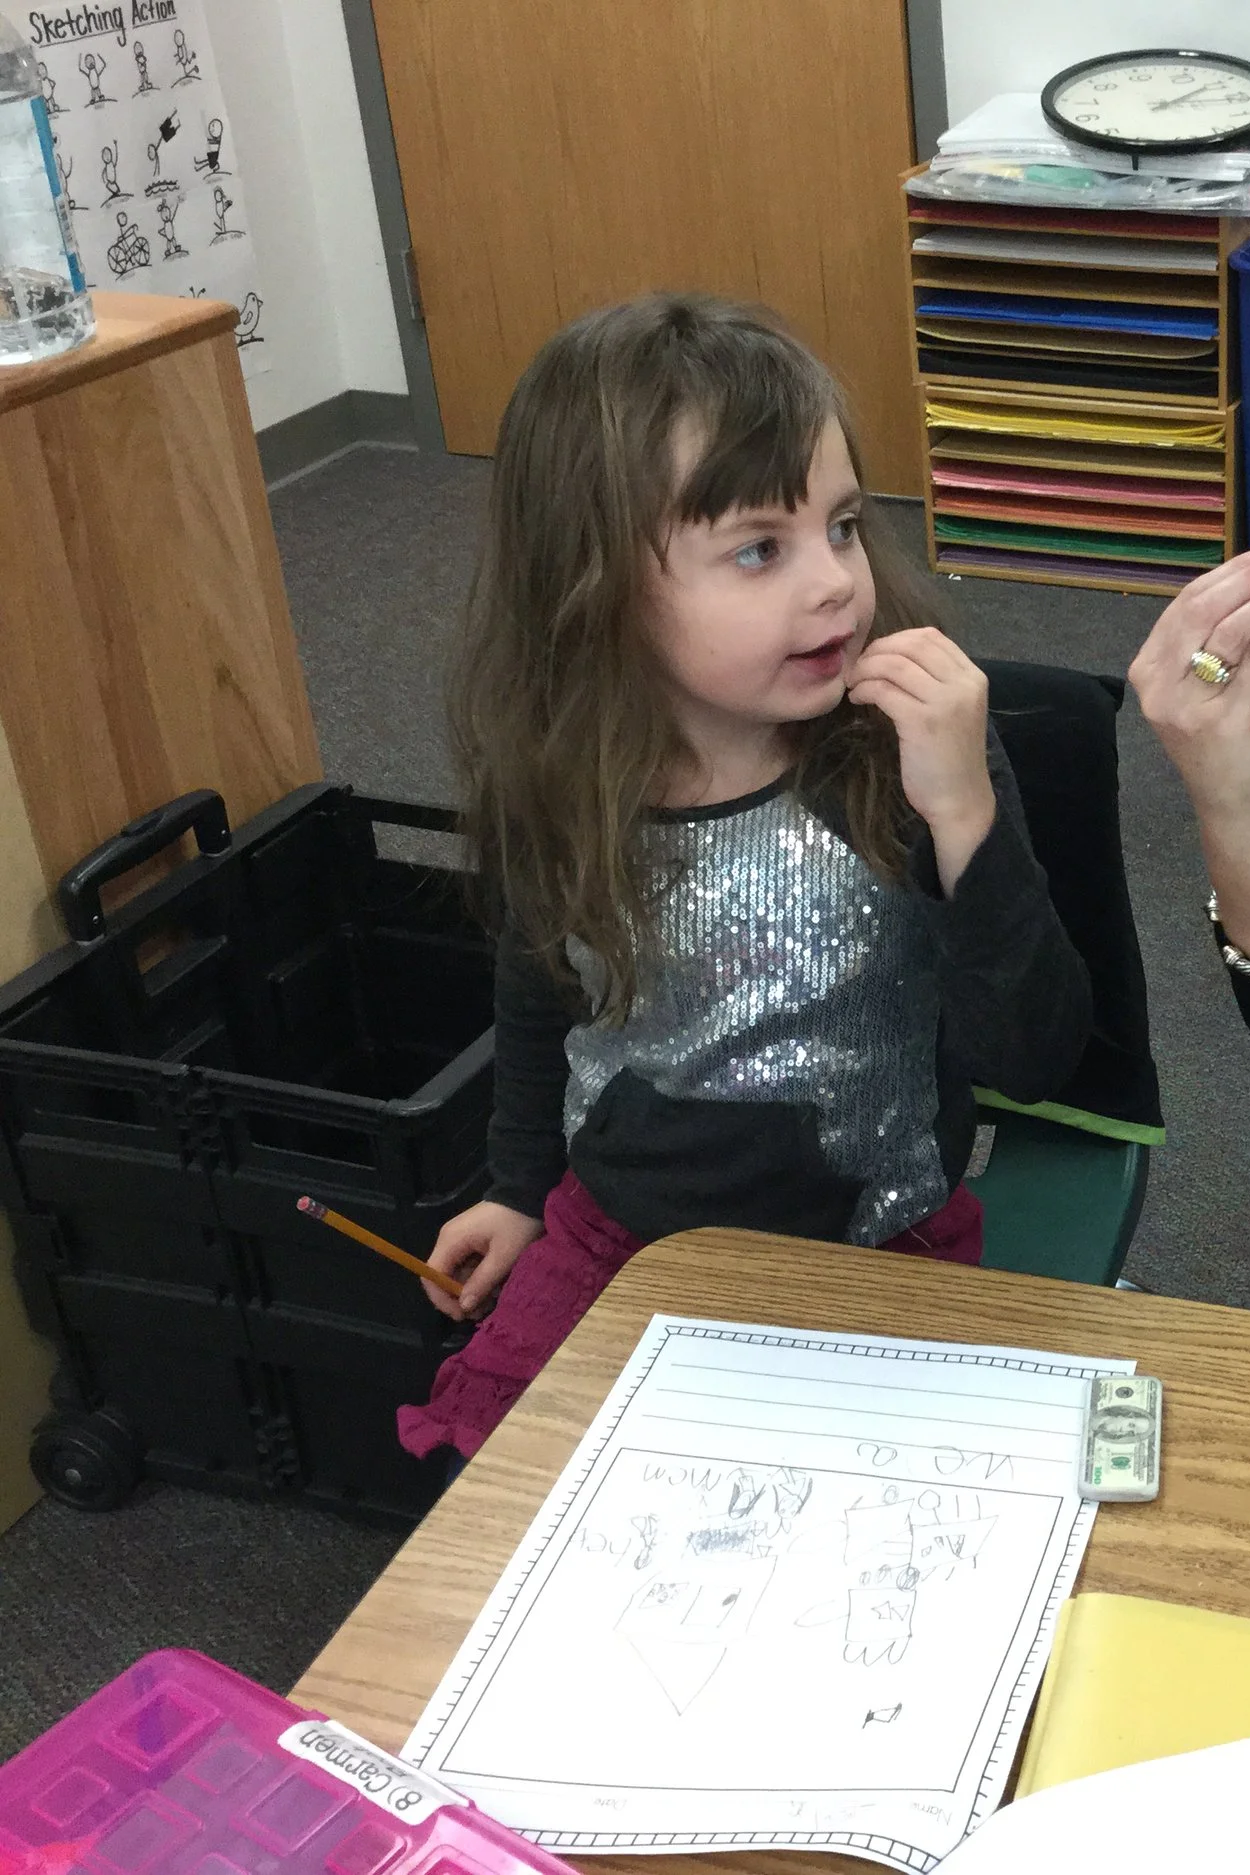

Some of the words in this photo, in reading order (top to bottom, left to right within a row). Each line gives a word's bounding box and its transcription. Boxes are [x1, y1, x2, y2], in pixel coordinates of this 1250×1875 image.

[29, 4, 127, 48] Sketching
[132, 0, 176, 26] Action
[1168, 73, 1195, 84] 10
[1094, 83, 1118, 92] 8
[1073, 97, 1099, 106] 7
[1075, 113, 1100, 122] 6
[299, 1729, 393, 1793] Carmen
